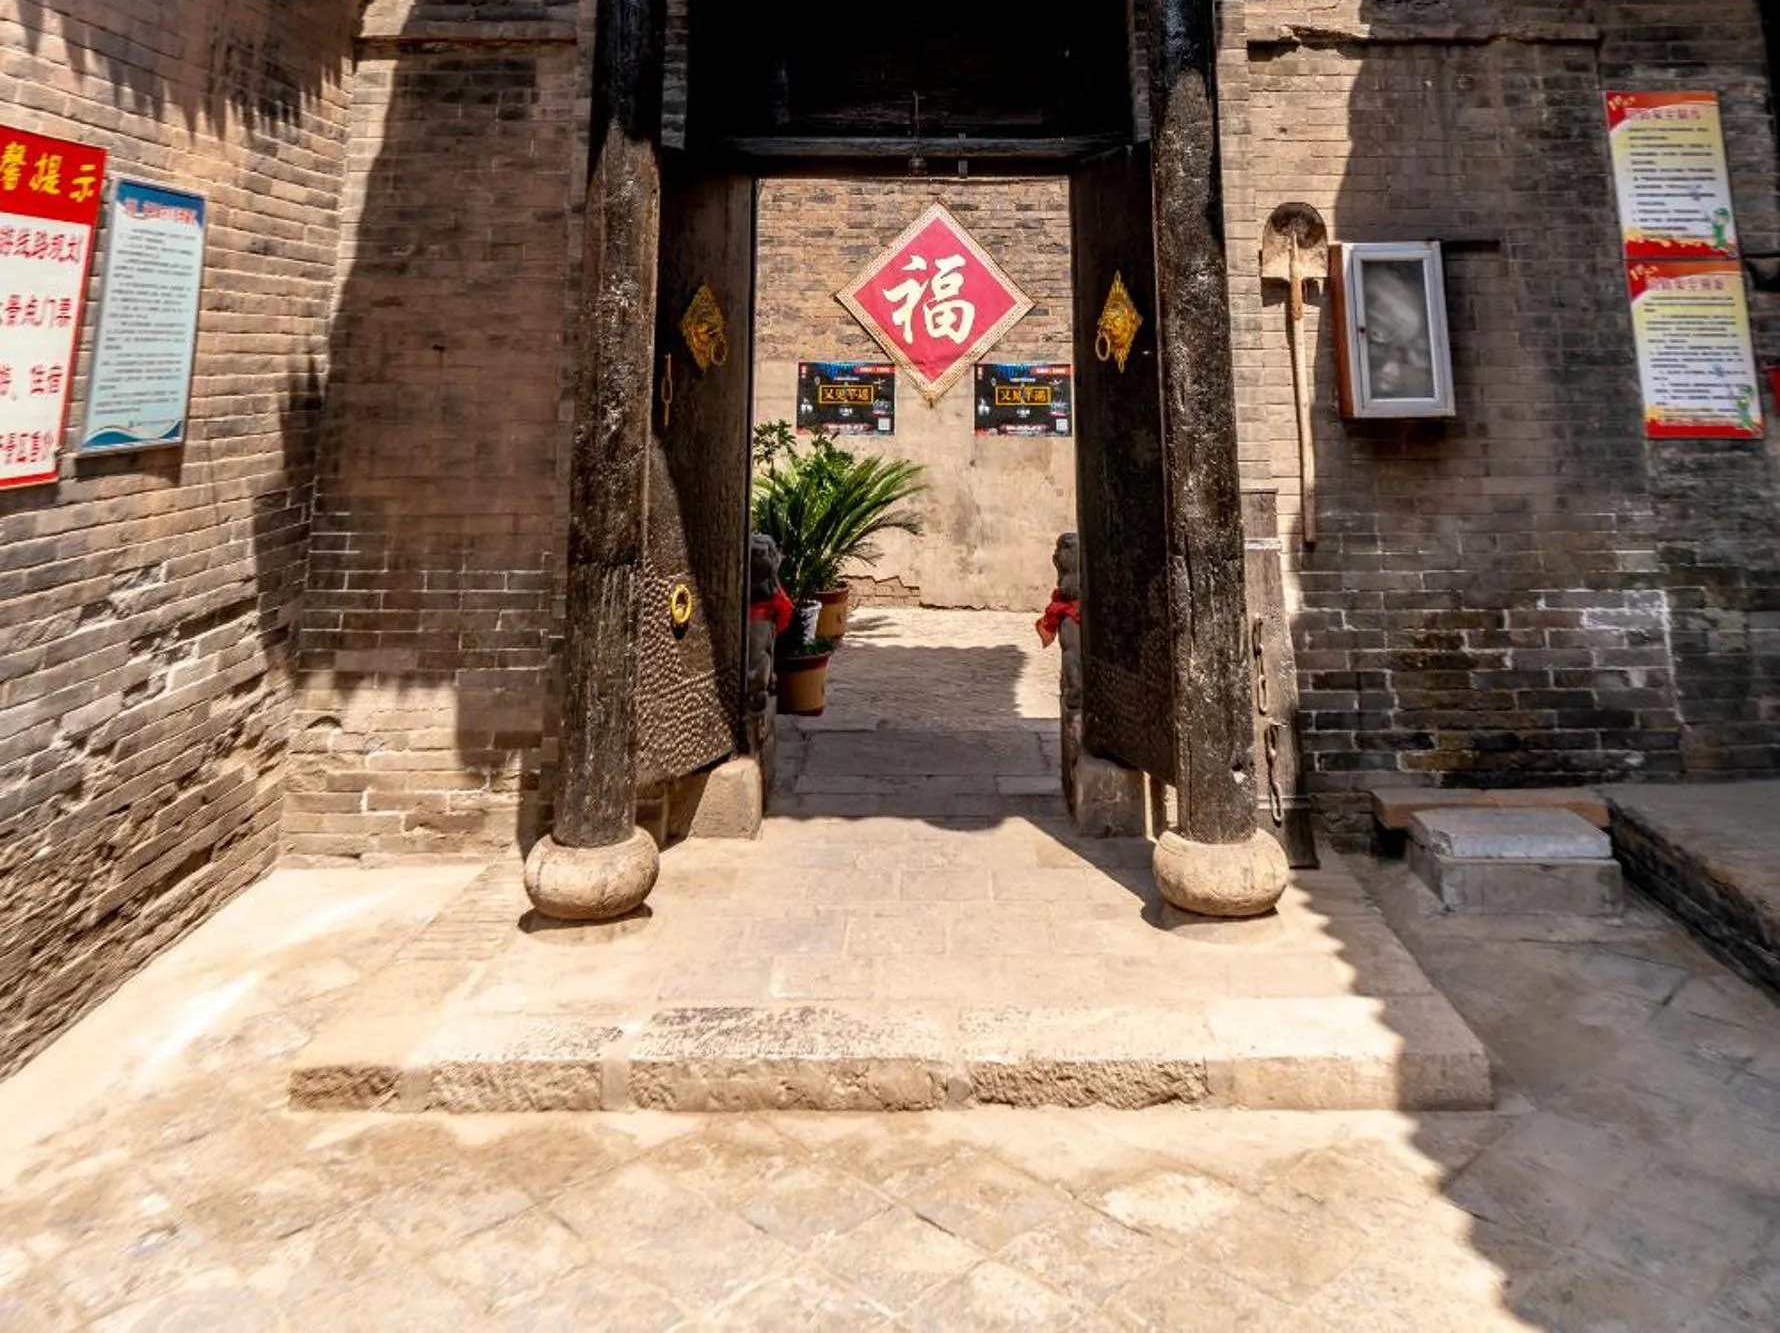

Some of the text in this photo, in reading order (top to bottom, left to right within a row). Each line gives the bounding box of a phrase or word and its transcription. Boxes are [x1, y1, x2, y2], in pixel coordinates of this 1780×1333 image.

[0, 294, 72, 328] 景点门票
[881, 253, 976, 345] 福
